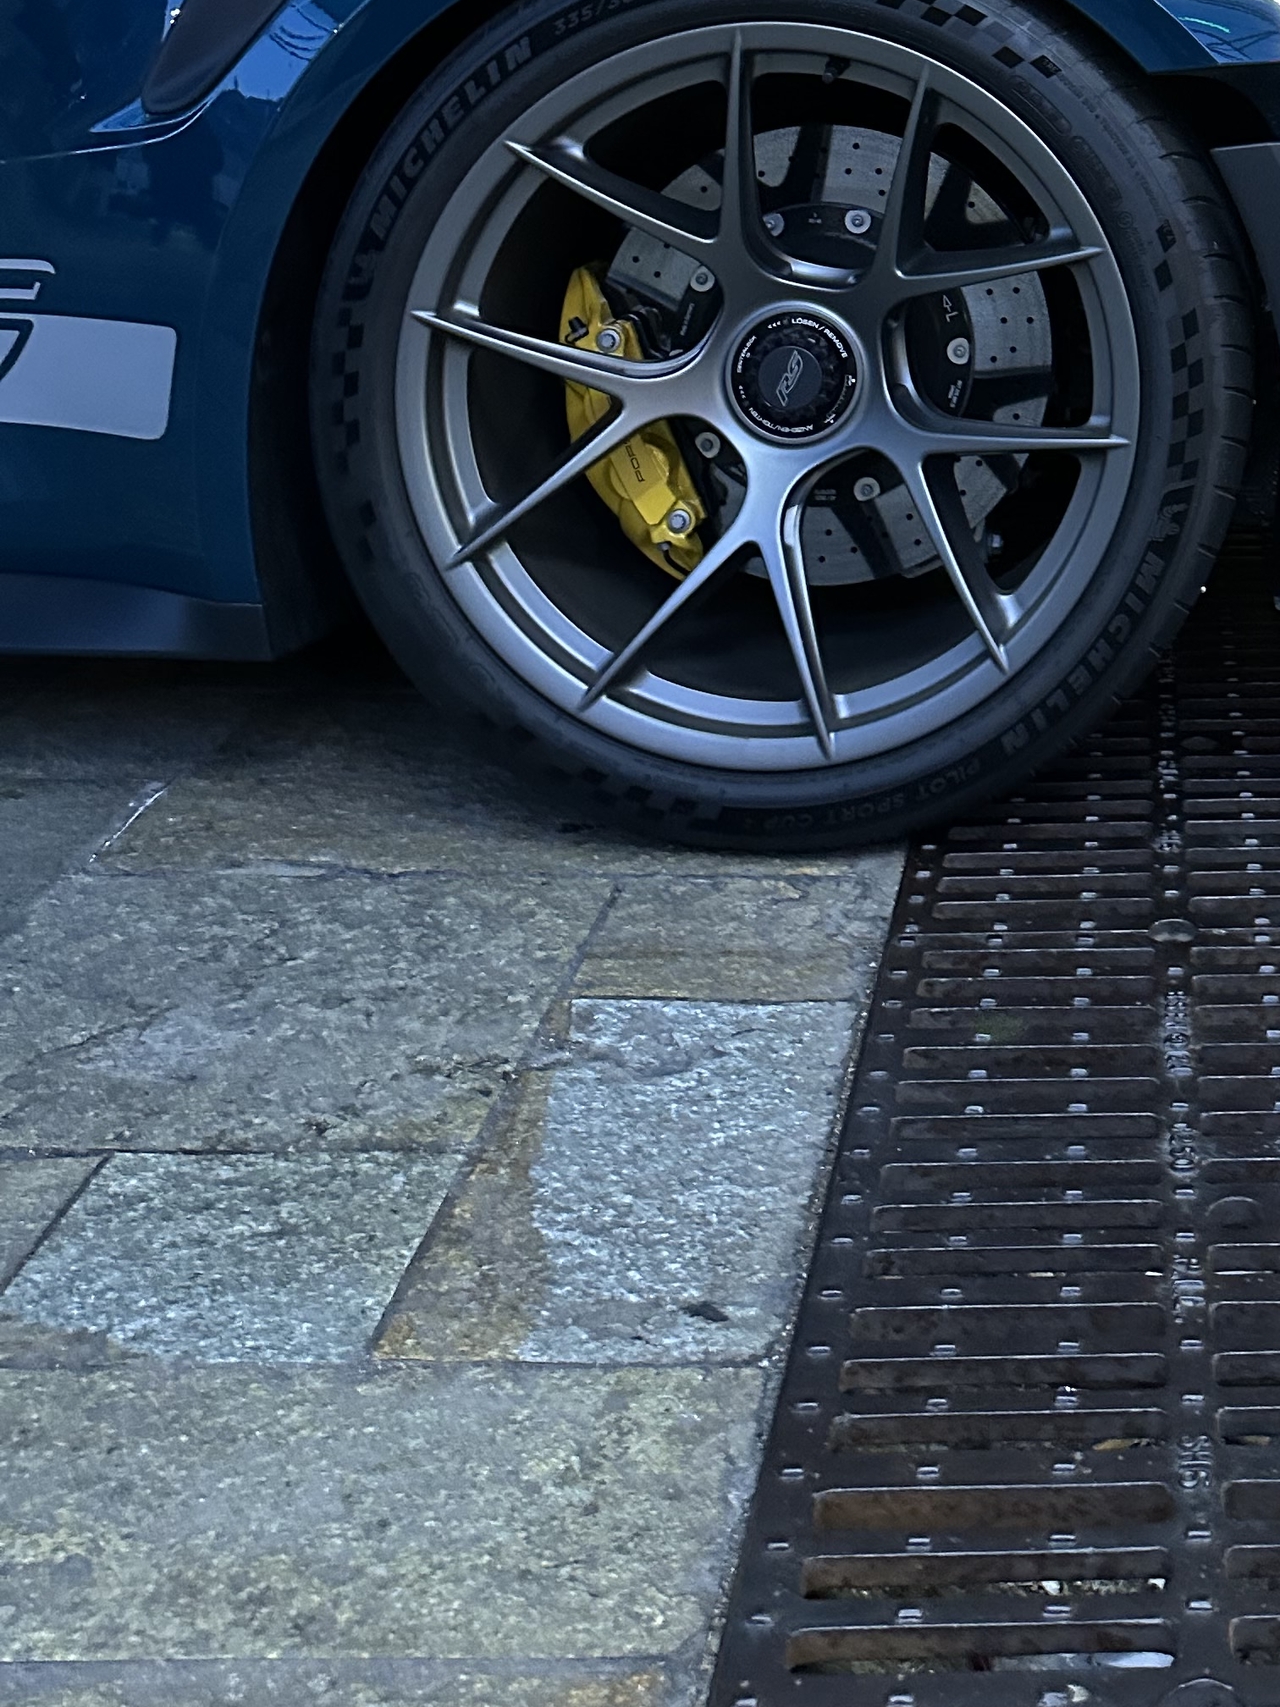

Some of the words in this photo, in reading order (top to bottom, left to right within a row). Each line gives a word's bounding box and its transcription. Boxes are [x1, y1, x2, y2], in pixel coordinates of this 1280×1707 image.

[369, 34, 534, 241] MICHELIN
[823, 327, 849, 359] REMOVE
[1000, 551, 1165, 754] MICHELIN
[826, 791, 905, 826] SPORT
